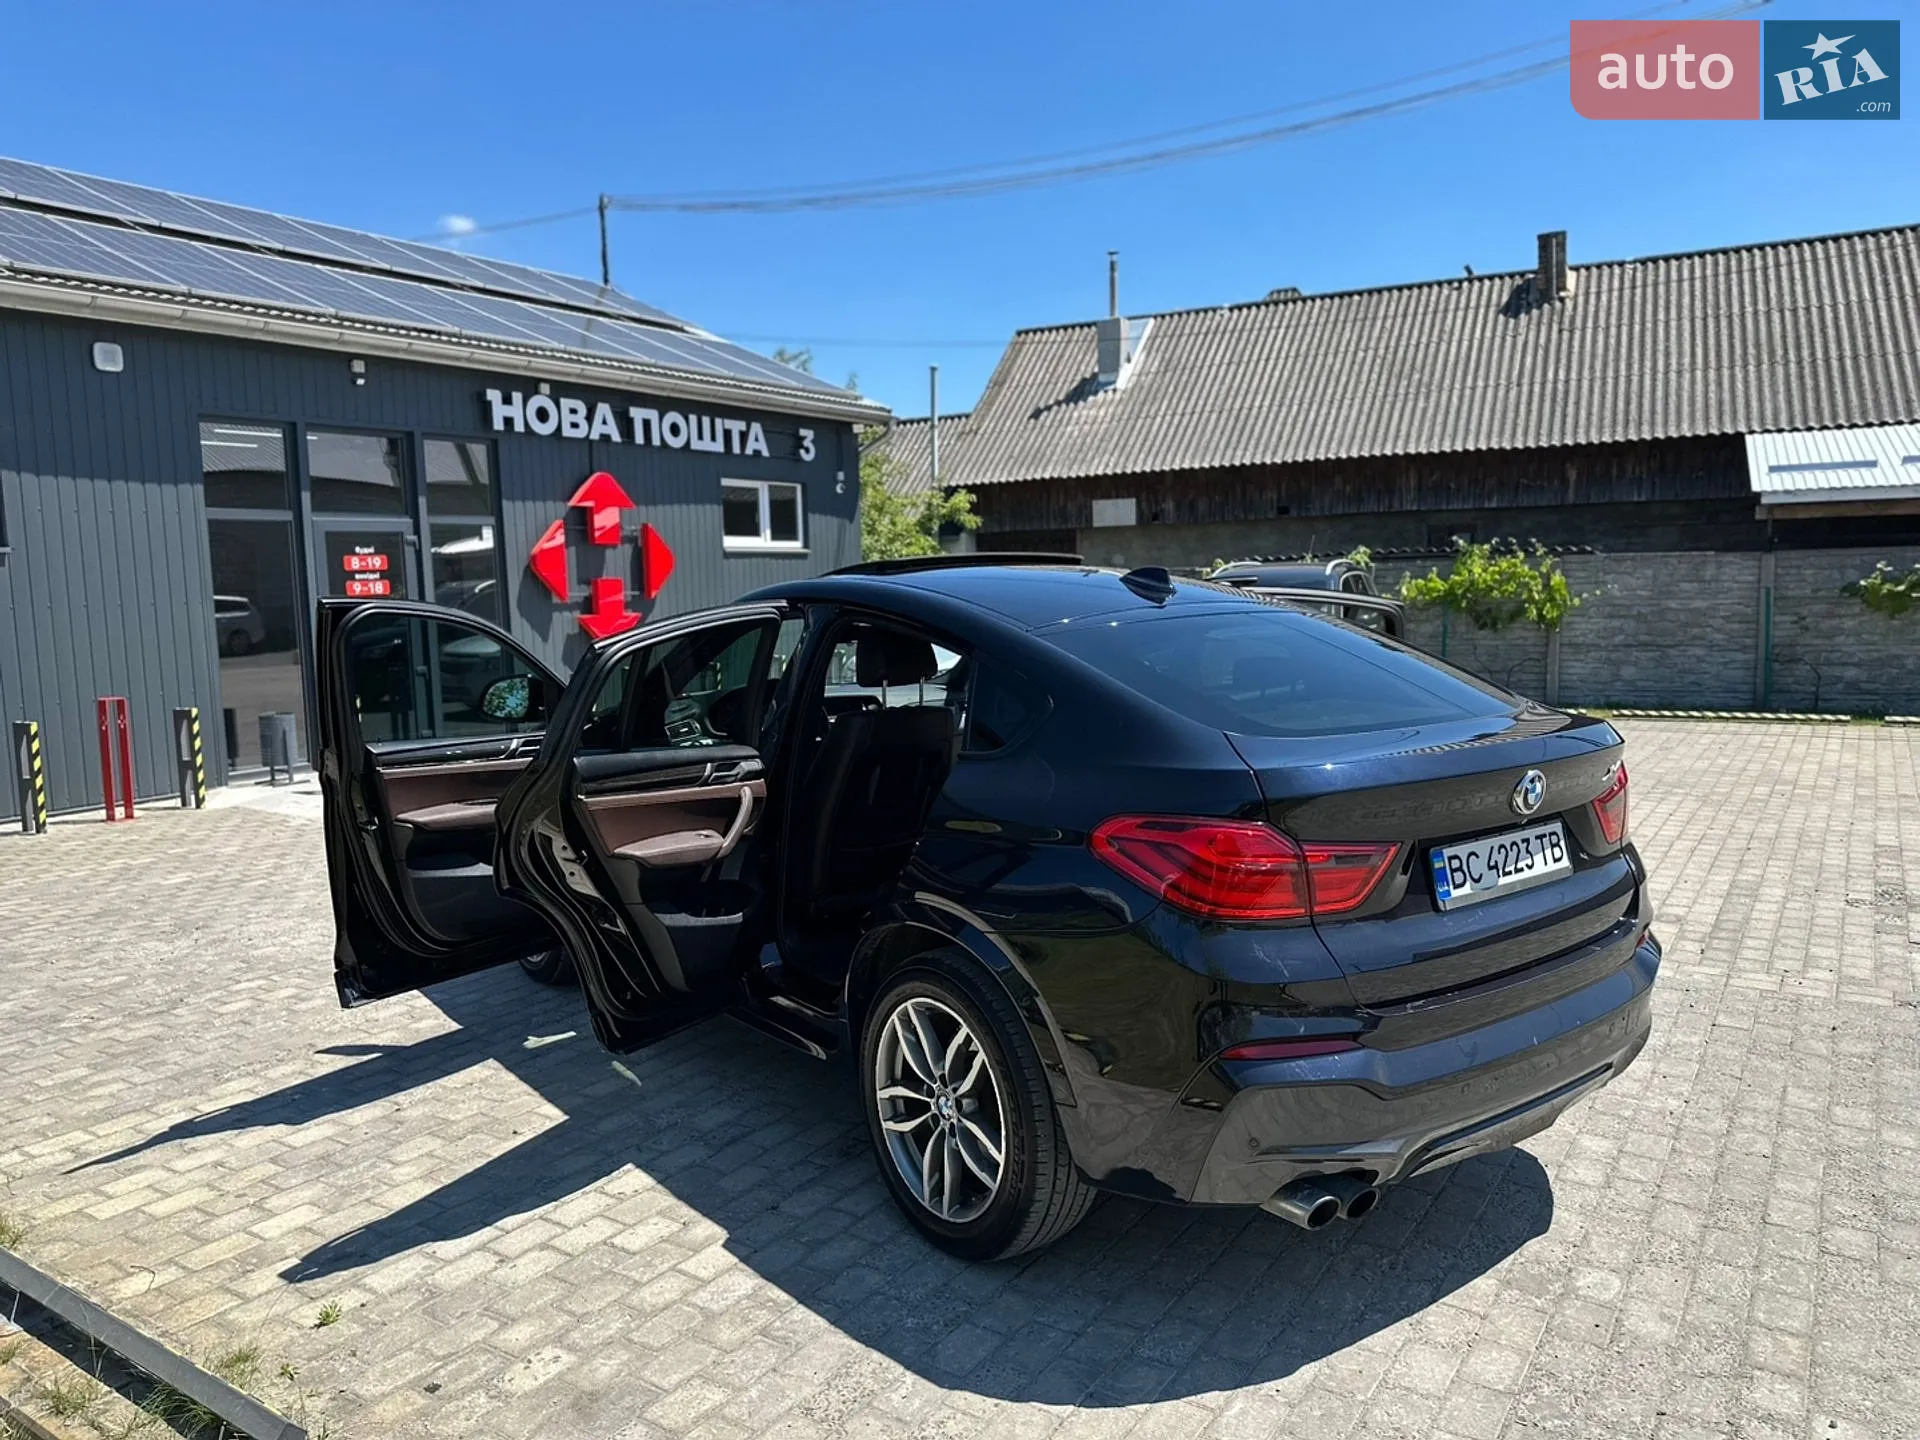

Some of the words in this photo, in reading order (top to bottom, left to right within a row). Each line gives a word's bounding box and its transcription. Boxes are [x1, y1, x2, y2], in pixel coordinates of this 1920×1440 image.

[485, 388, 622, 443] НОВА
[628, 405, 770, 457] ПОШТА
[799, 429, 816, 462] 3
[1448, 852, 1483, 889] BC
[1486, 838, 1536, 878] 4223
[1535, 832, 1563, 866] TB
